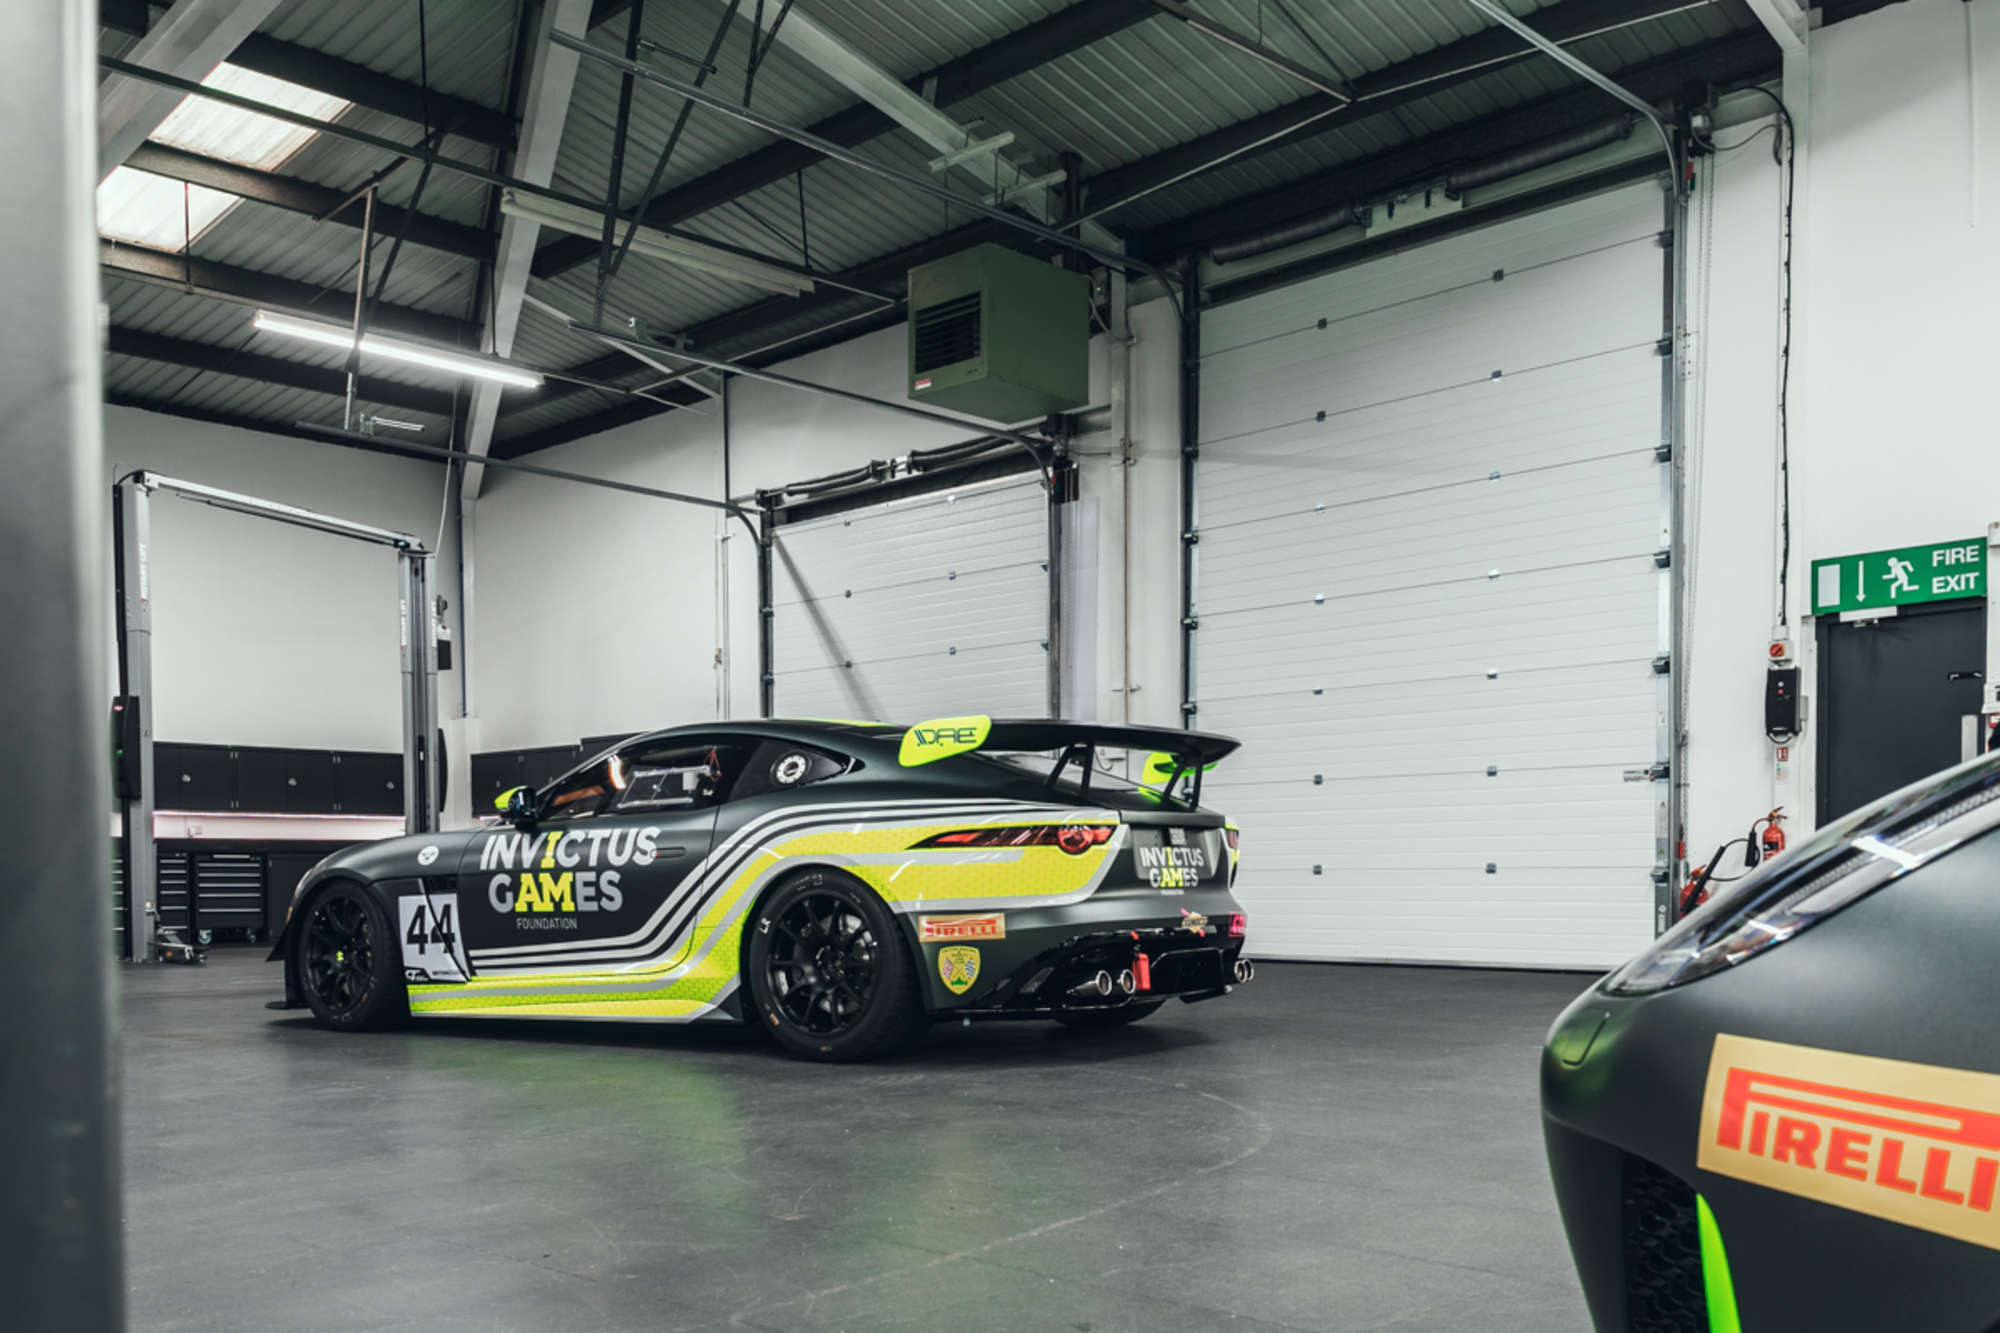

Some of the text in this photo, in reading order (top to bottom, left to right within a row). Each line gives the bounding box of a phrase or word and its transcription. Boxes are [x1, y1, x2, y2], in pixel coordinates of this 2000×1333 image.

[1932, 545, 1980, 567] FIRE
[1932, 572, 1980, 594] EXIT
[480, 827, 661, 870] INVICTUS
[1140, 847, 1204, 867] INVICTUS
[1149, 867, 1199, 888] GAMES
[488, 870, 623, 913] GAMES
[406, 903, 456, 955] 44
[516, 917, 578, 930] FOUNDATION
[925, 919, 997, 937] PIRELLI
[1716, 1066, 2000, 1212] PIRELLI
